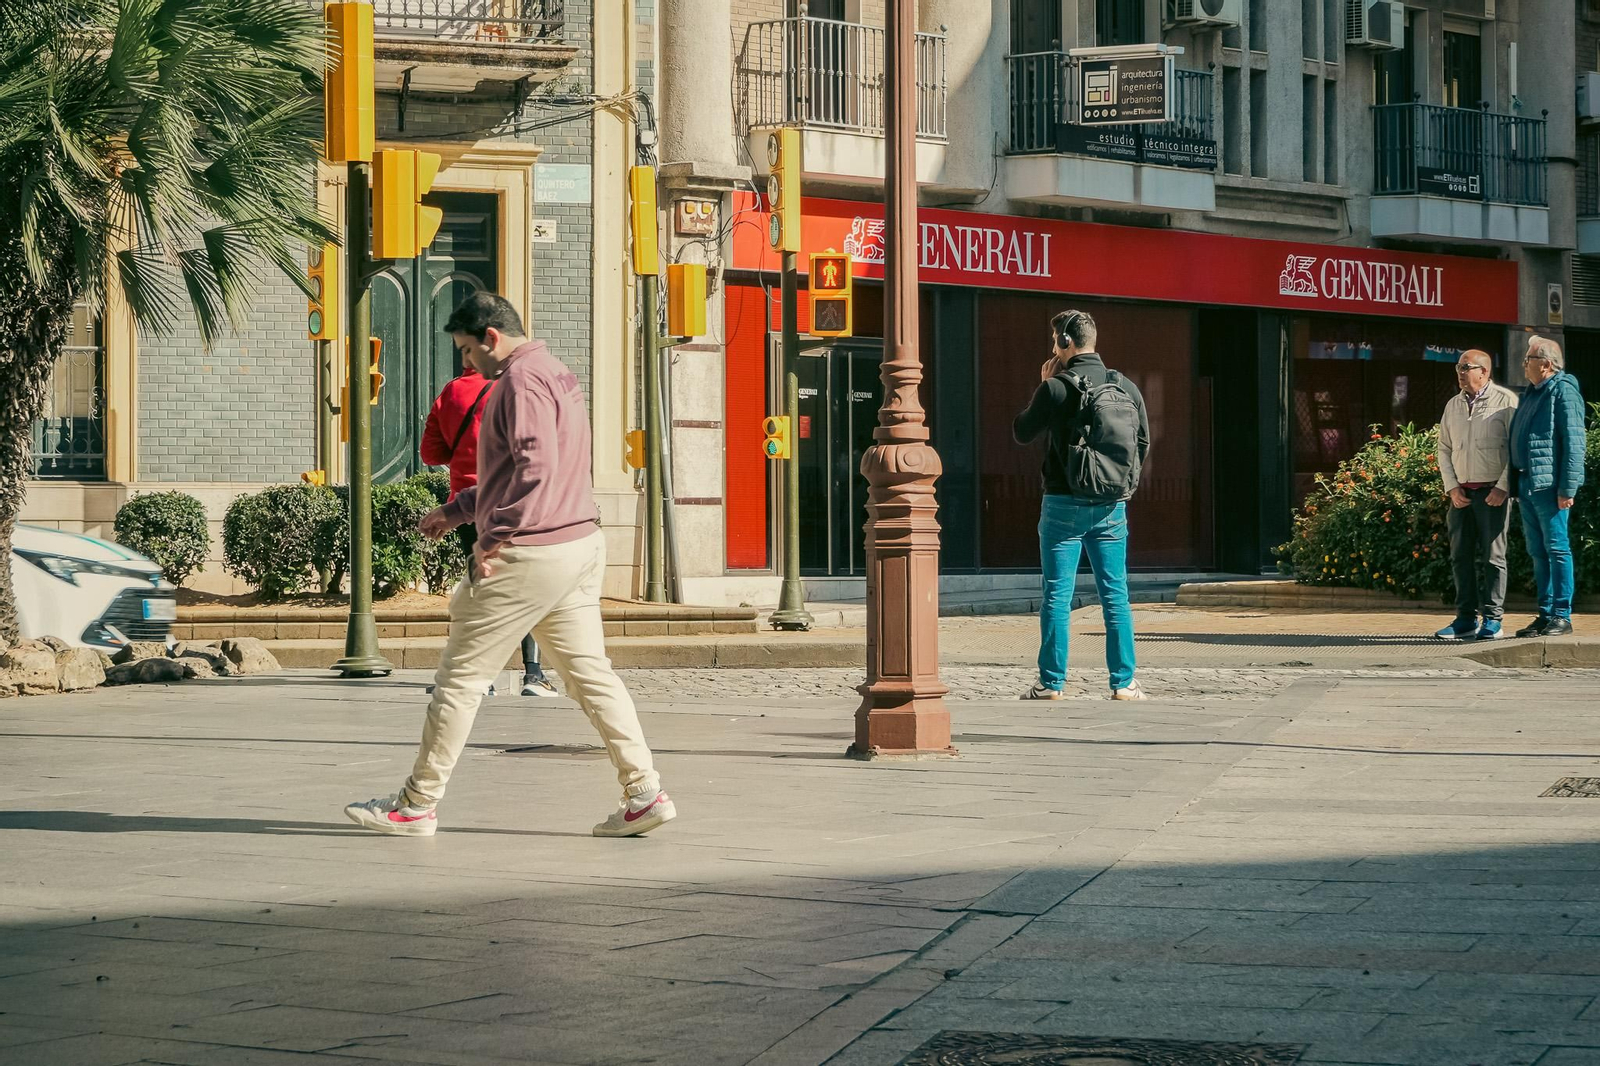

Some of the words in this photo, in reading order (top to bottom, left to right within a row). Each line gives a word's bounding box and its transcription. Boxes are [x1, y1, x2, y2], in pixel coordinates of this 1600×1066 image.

[1121, 69, 1163, 80] arquitectura
[1121, 80, 1163, 93] ingeniería
[1121, 95, 1163, 105] urbanismo
[1099, 133, 1135, 146] estudio
[1144, 137, 1179, 152] técnico
[1181, 140, 1217, 156] integral
[537, 179, 575, 189] QUINTERO
[917, 222, 1052, 277] ENERALI
[1320, 257, 1444, 307] GENERALI
